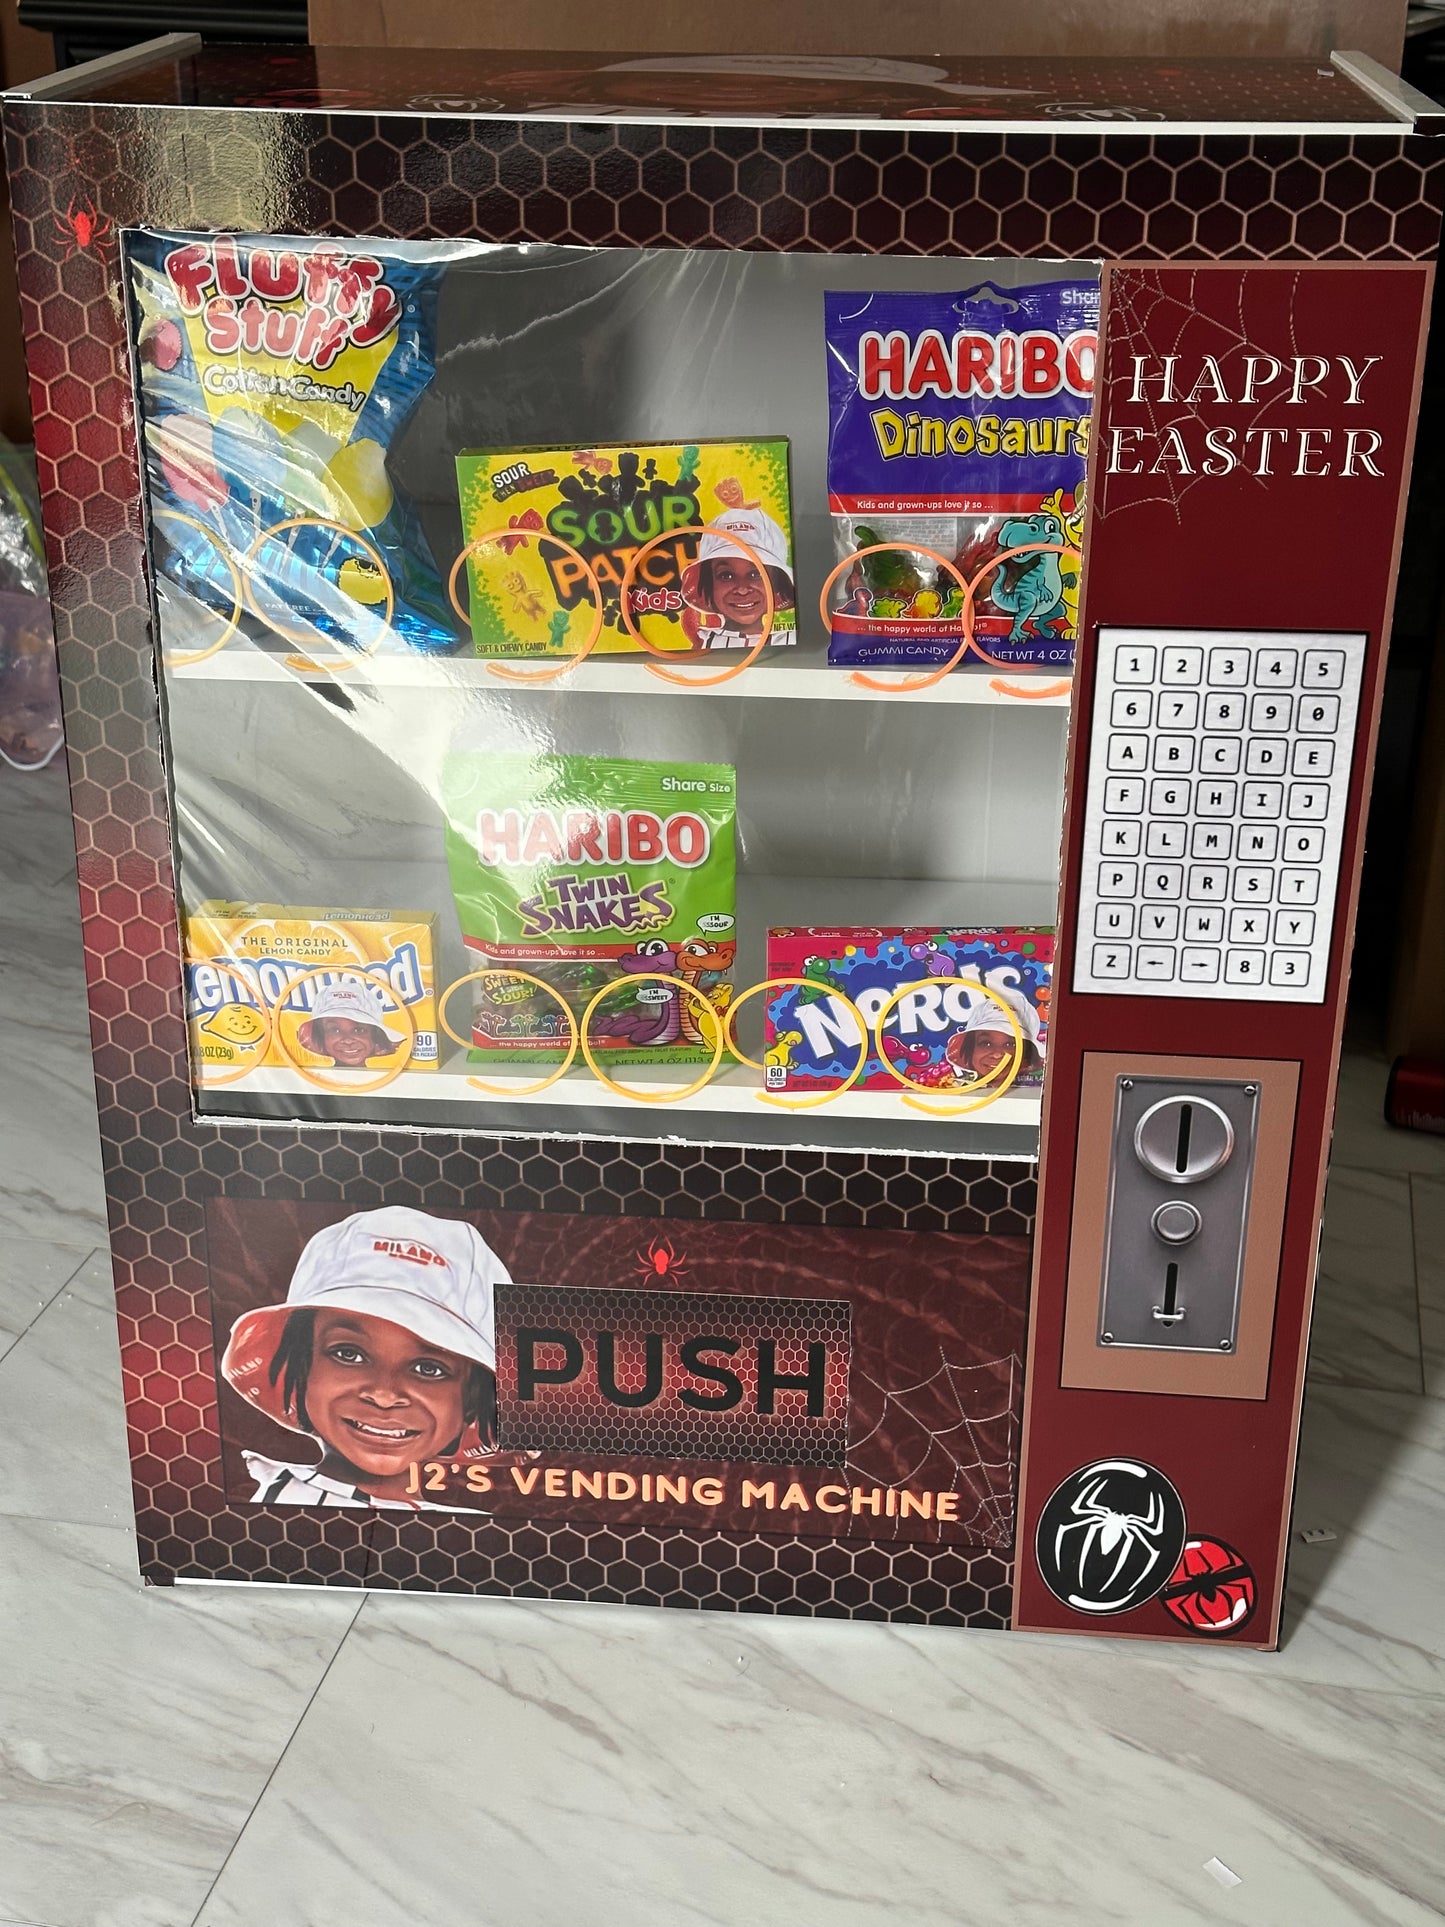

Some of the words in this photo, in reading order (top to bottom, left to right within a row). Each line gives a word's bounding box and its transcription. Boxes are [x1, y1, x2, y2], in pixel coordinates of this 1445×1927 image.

[1061, 288, 1100, 304] Shar
[204, 296, 352, 369] Stuff
[861, 332, 1098, 398] HARIBO
[1127, 354, 1383, 404] HAPPY
[291, 374, 366, 412] Candy
[870, 408, 1090, 461] Dinosaurs
[1105, 426, 1385, 477] EASTER
[493, 463, 531, 489] SOUR
[857, 501, 876, 509] Kids
[878, 501, 895, 509] and
[897, 501, 942, 511] grown-ups
[944, 500, 962, 509] love
[551, 496, 696, 548] SOUR
[550, 541, 702, 598] PATCH
[627, 587, 682, 613] Kids
[868, 624, 882, 632] the
[884, 624, 911, 633] happy
[912, 624, 937, 632] world
[938, 624, 949, 632] of
[476, 644, 492, 653] SOFT
[500, 642, 524, 652] CHEWY
[525, 641, 547, 651] CANDY
[858, 646, 904, 657] GUMMI
[906, 646, 949, 657] CANDY
[991, 650, 1014, 660] NET
[1016, 650, 1035, 660] WT
[1037, 650, 1045, 660] 4
[1049, 650, 1067, 660] OZ
[1130, 658, 1140, 672] 1
[1176, 658, 1187, 673] 2
[1223, 659, 1234, 675] 3
[1269, 661, 1282, 676] 4
[1317, 662, 1329, 677] 5
[1126, 702, 1137, 716] 6
[1173, 703, 1184, 717] 7
[1218, 704, 1230, 719] 8
[1265, 705, 1277, 720] 9
[1122, 745, 1134, 760] A
[1168, 747, 1180, 761] B
[1214, 748, 1226, 763] C
[1260, 749, 1273, 764] D
[1308, 751, 1319, 765] E
[662, 777, 706, 793] Share
[709, 781, 731, 793] Size
[1119, 788, 1129, 802] F
[1164, 790, 1176, 804] G
[1210, 791, 1222, 805] H
[1256, 793, 1268, 807] I
[1303, 794, 1313, 809] J
[478, 810, 709, 866] HARIBO
[1115, 831, 1127, 845] K
[1161, 832, 1171, 846] L
[1205, 834, 1218, 848] M
[1251, 836, 1264, 850] N
[1297, 837, 1310, 851] O
[550, 873, 630, 899] TWIN
[1112, 873, 1124, 886] P
[1156, 874, 1169, 891] Q
[1202, 876, 1213, 890] R
[1247, 878, 1259, 892] S
[1294, 879, 1305, 893] T
[519, 880, 676, 936] SNAKES
[1109, 914, 1120, 927] U
[1154, 916, 1166, 929] V
[1198, 917, 1211, 931] W
[1243, 919, 1255, 933] X
[1289, 921, 1301, 934] Y
[241, 936, 267, 946] THE
[275, 937, 348, 948] ORIGINAL
[260, 947, 293, 955] LEMON
[296, 948, 332, 956] CANDY
[485, 943, 498, 954] Kids
[517, 948, 559, 957] grown-ups
[560, 948, 577, 956] love
[1106, 954, 1117, 968] Z
[1239, 960, 1251, 973] 8
[1284, 962, 1295, 975] 3
[416, 1034, 432, 1046] 90
[216, 1046, 234, 1060] (23g)
[770, 1067, 783, 1078] 60
[373, 1240, 448, 1268] MILANO
[516, 1326, 827, 1418] PUSH
[406, 1461, 493, 1493] J2'S
[510, 1467, 725, 1507] VENDING
[741, 1479, 961, 1522] MACHINE
